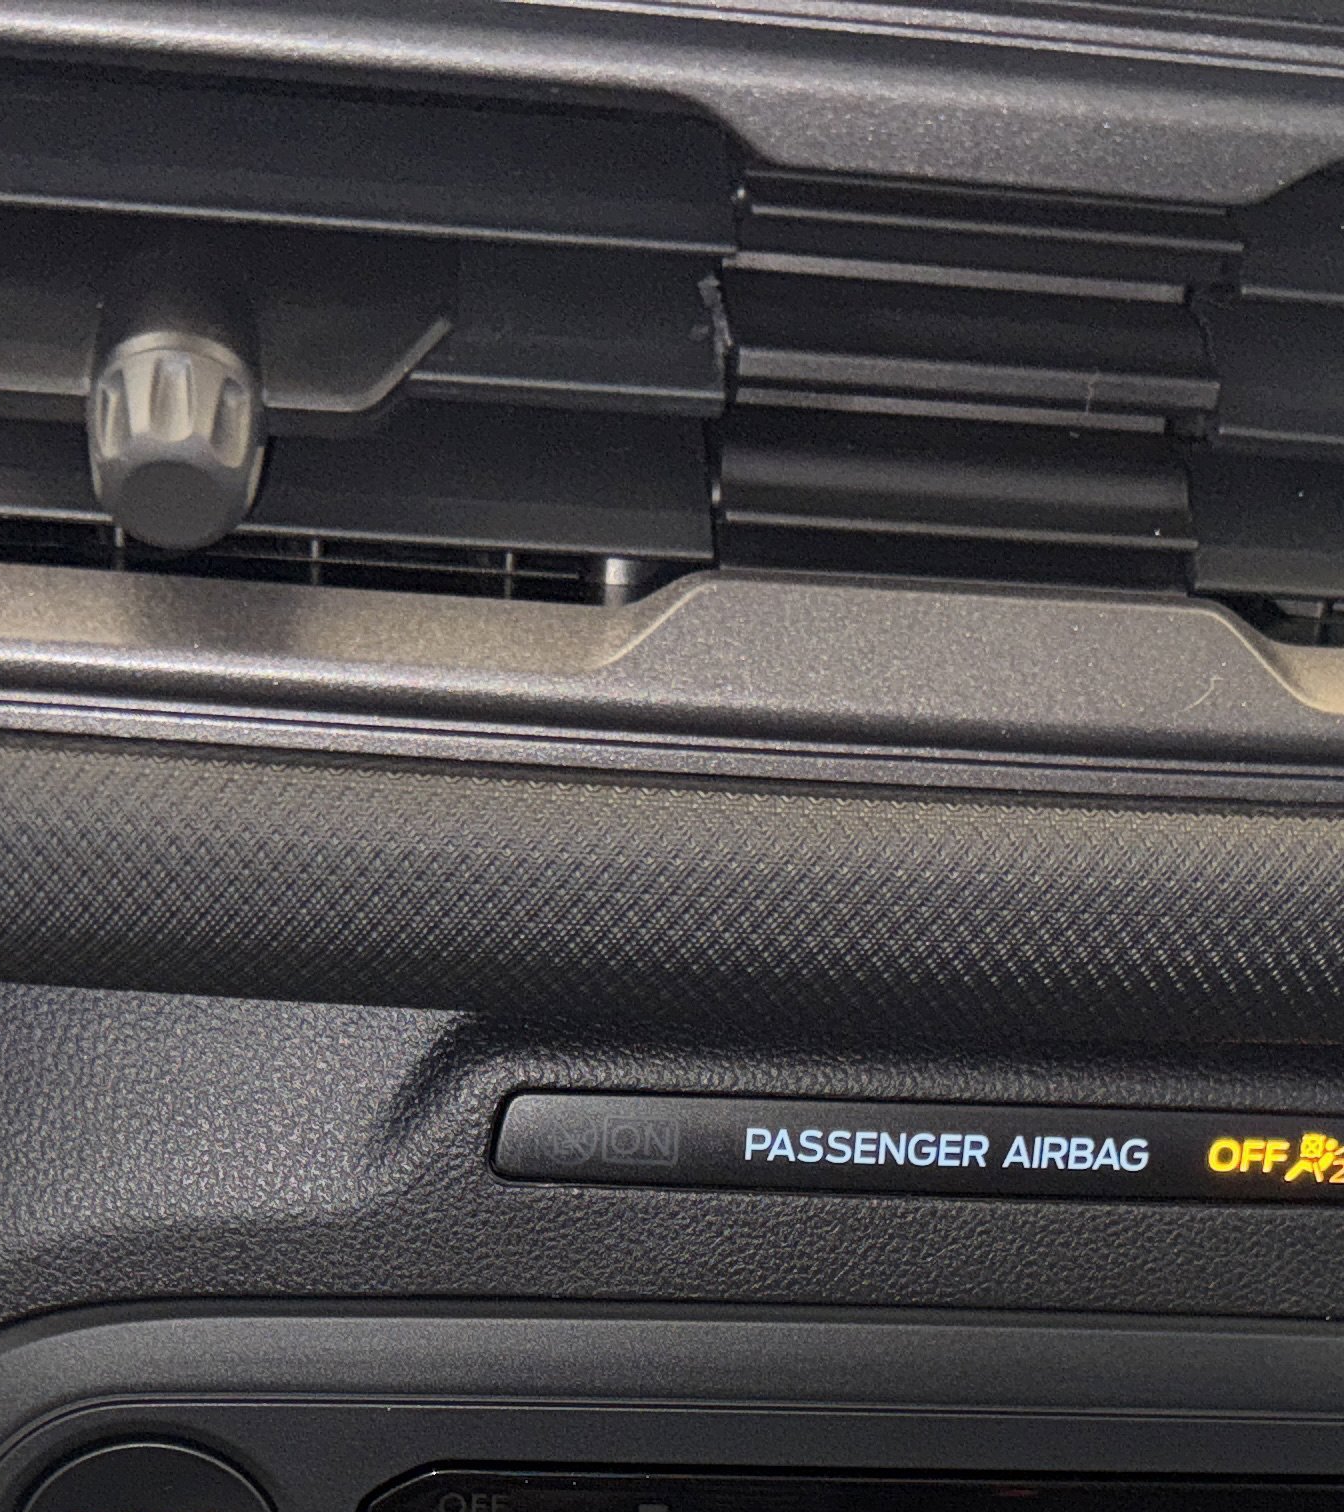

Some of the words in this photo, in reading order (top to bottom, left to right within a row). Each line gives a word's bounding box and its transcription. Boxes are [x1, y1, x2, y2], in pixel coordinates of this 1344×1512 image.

[611, 1122, 670, 1158] ON
[744, 1126, 990, 1169] PASSENGER
[1001, 1135, 1150, 1173] AIRBAG
[1207, 1136, 1291, 1174] OFF
